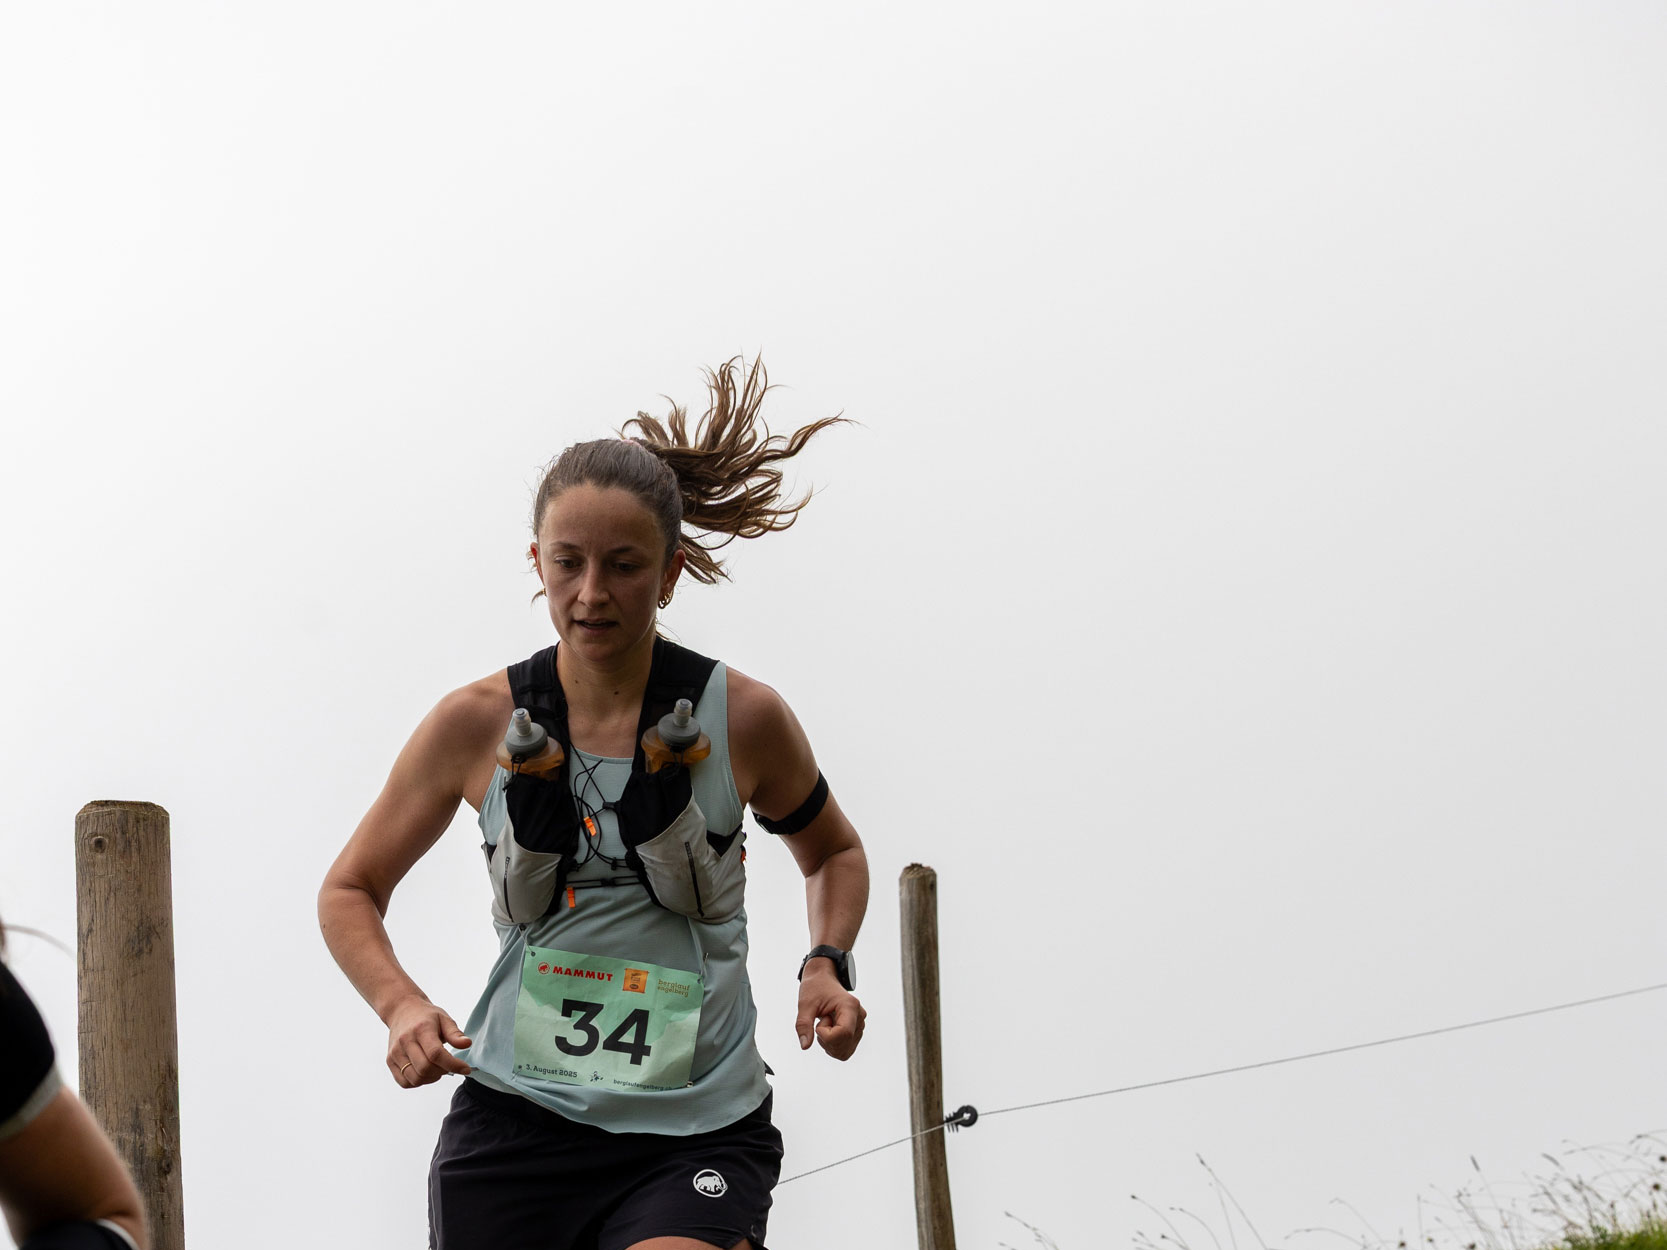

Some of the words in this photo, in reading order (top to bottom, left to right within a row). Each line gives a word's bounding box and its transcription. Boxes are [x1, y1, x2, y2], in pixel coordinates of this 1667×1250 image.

[552, 965, 613, 982] MAMMUT
[658, 979, 690, 991] berglauf
[657, 986, 688, 998] engelberg
[554, 998, 652, 1067] 34
[533, 1065, 557, 1075] August
[559, 1069, 578, 1078] 2025
[613, 1079, 672, 1091] berglaufengelbergch
